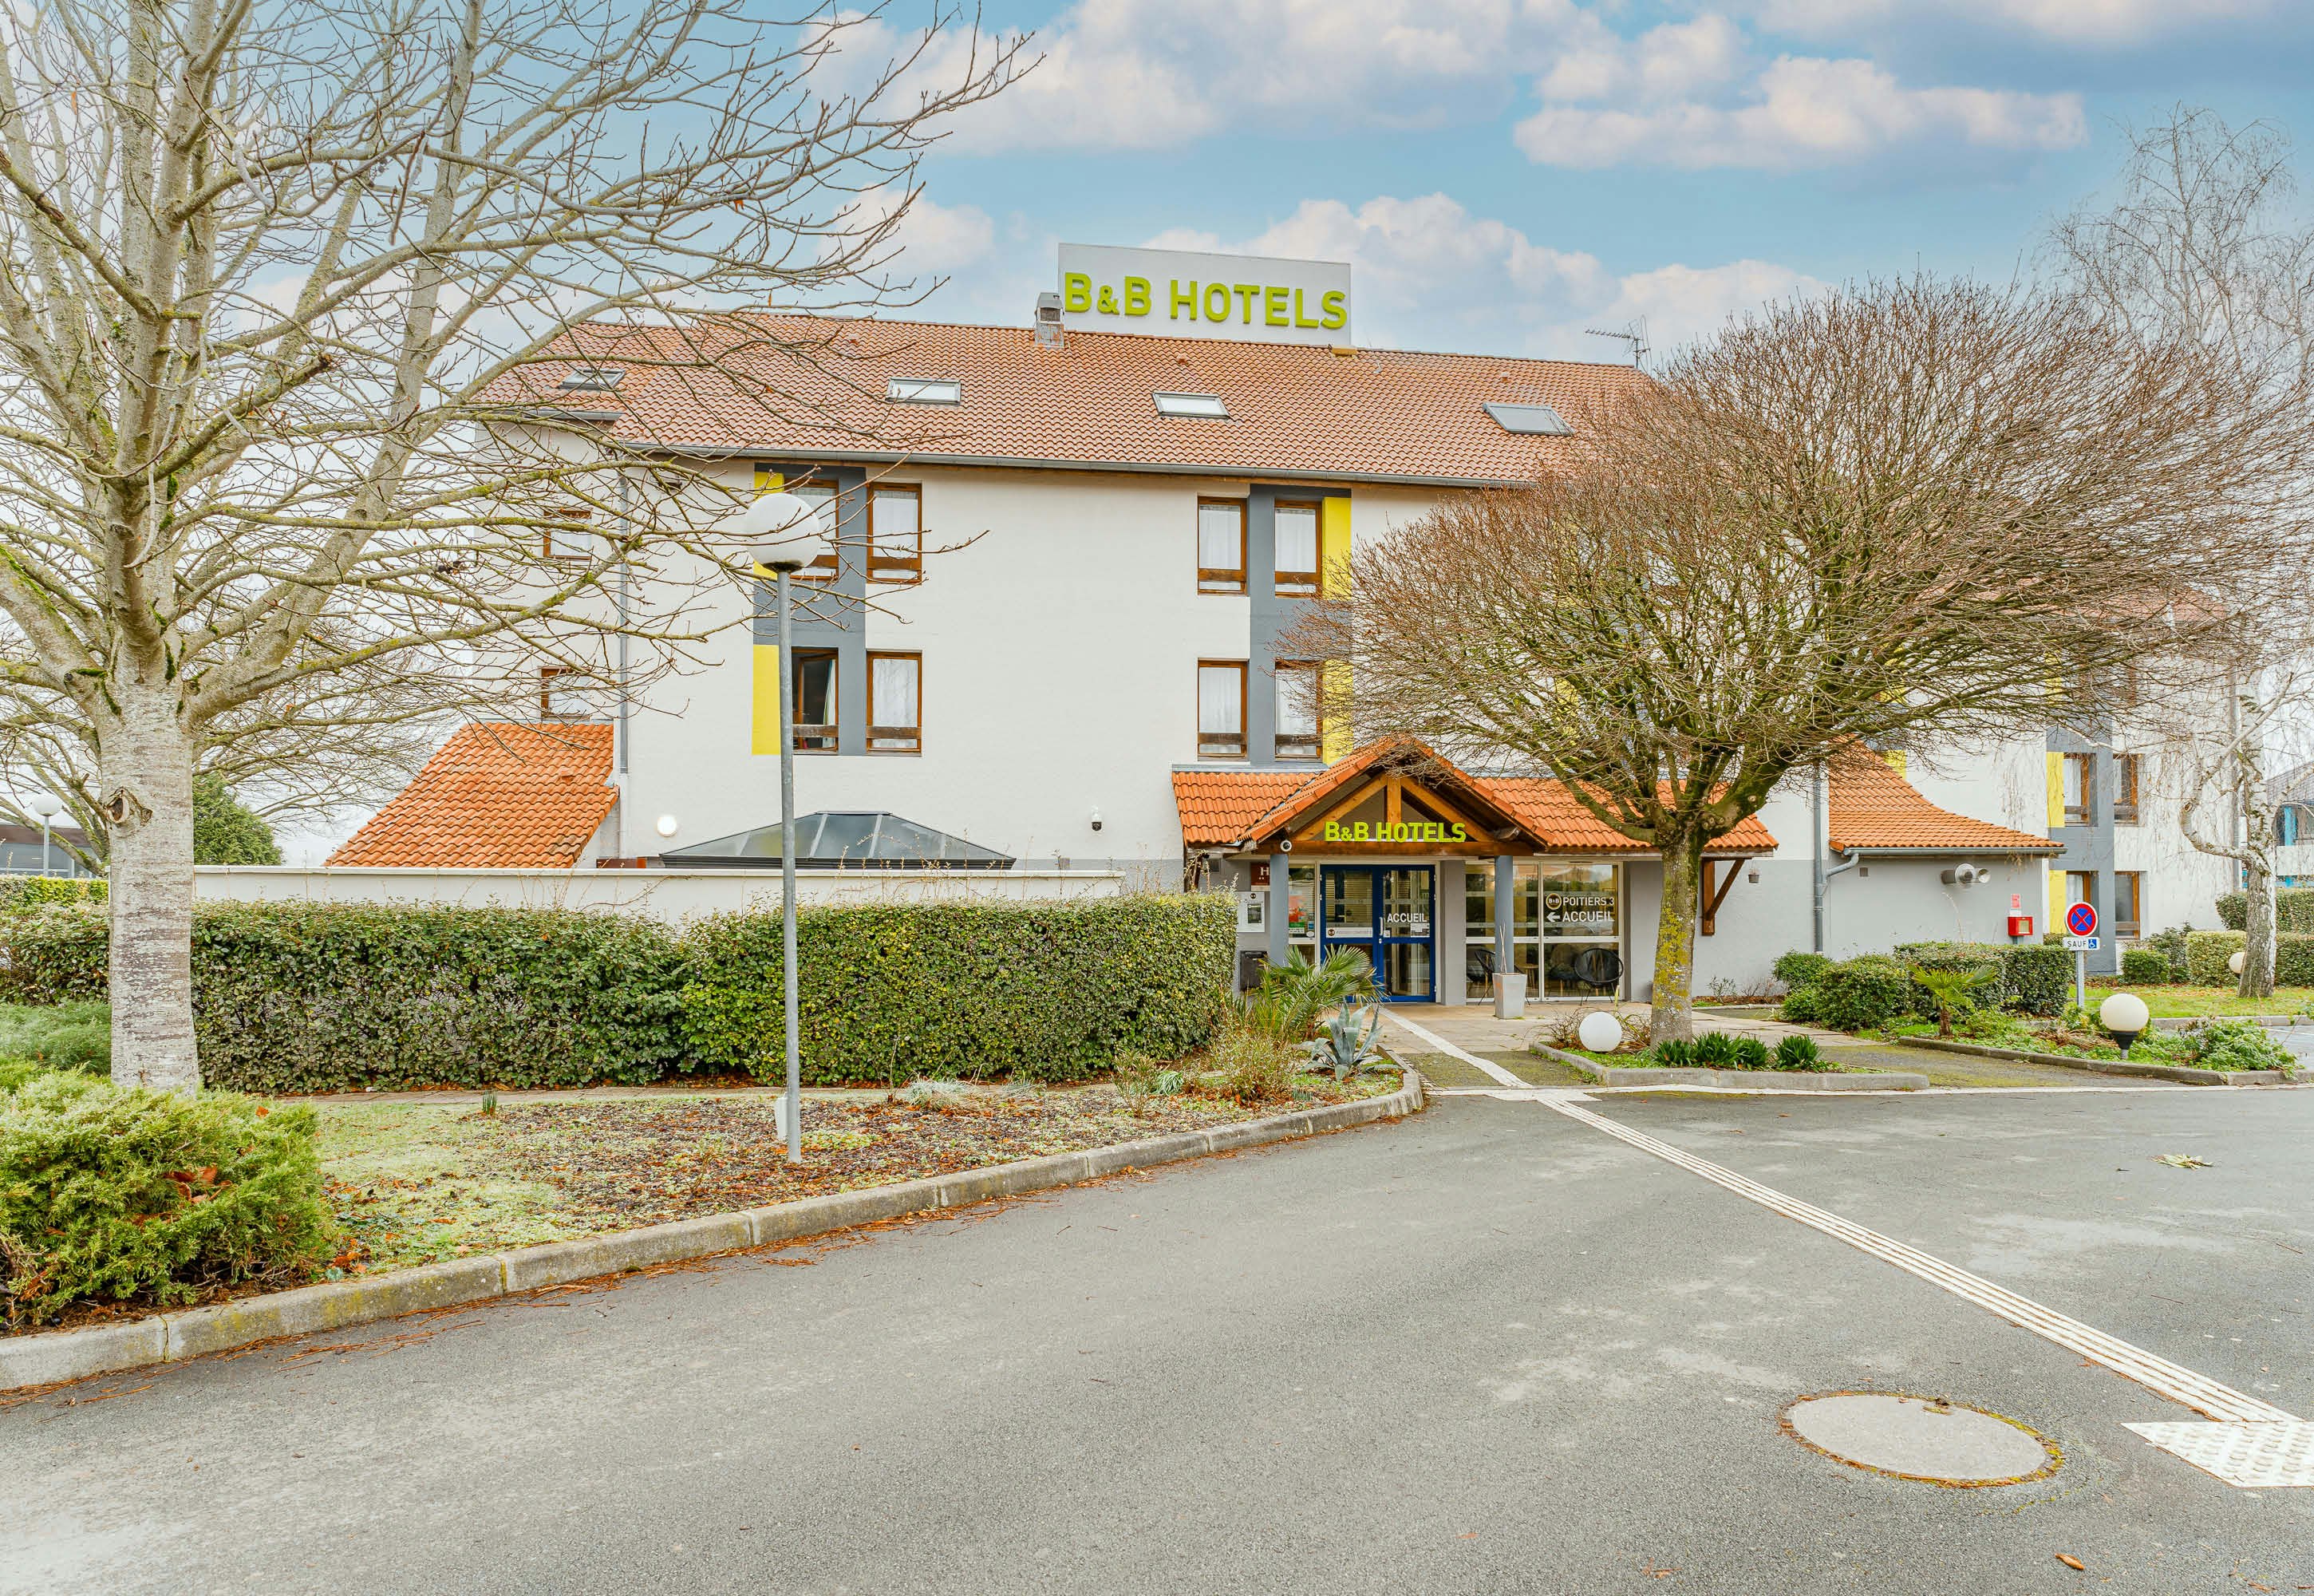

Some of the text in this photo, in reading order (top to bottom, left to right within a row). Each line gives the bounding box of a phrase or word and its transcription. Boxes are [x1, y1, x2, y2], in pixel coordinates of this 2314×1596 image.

[1064, 272, 1348, 330] B&B HOTELS
[1325, 821, 1467, 843] B&B HOTELS
[1260, 867, 1270, 875] H
[1562, 897, 1615, 906] POITIERS 3
[1387, 913, 1427, 922] ACCUEIL
[1562, 911, 1615, 922] ACCUEIL
